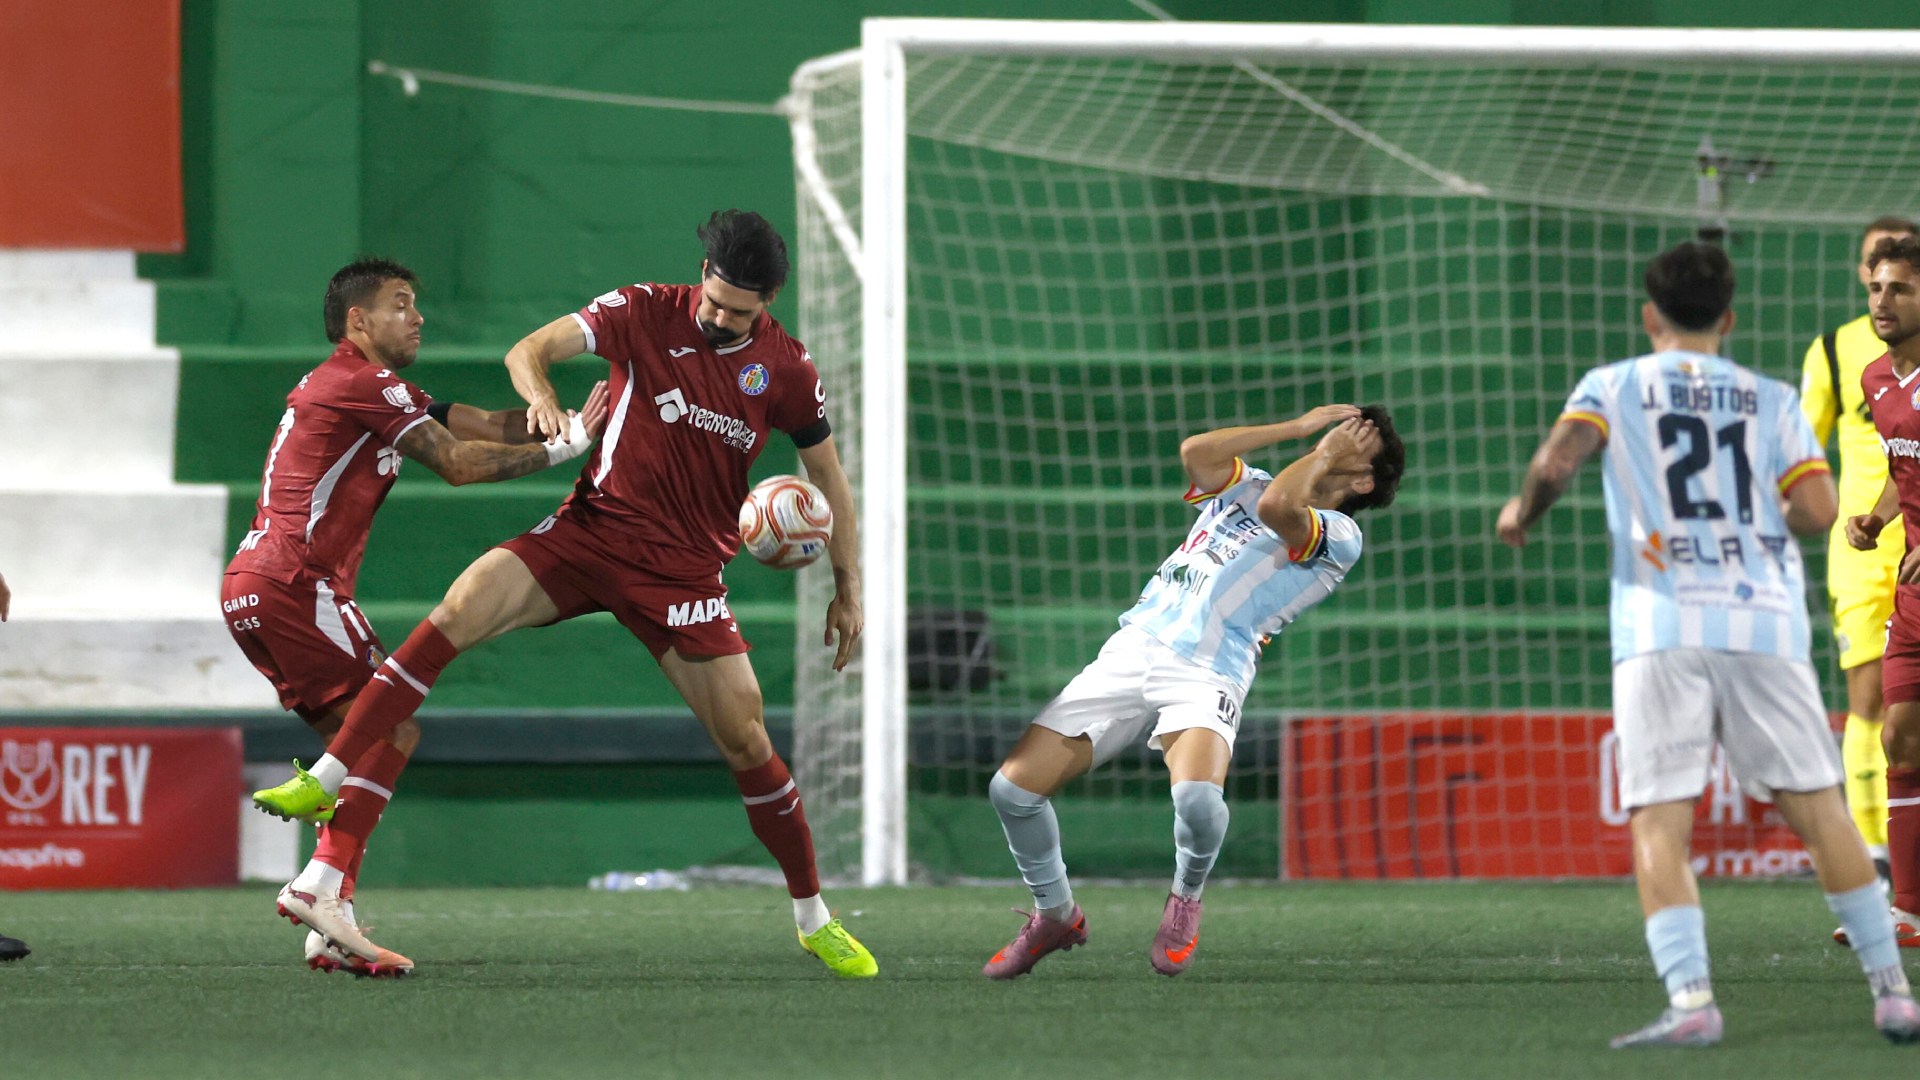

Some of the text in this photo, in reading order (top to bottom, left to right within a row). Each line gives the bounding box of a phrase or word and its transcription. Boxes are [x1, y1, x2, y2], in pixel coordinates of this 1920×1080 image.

[1670, 383, 1758, 416] BUSTOS
[1658, 413, 1754, 525] 21
[61, 743, 152, 826] REY
